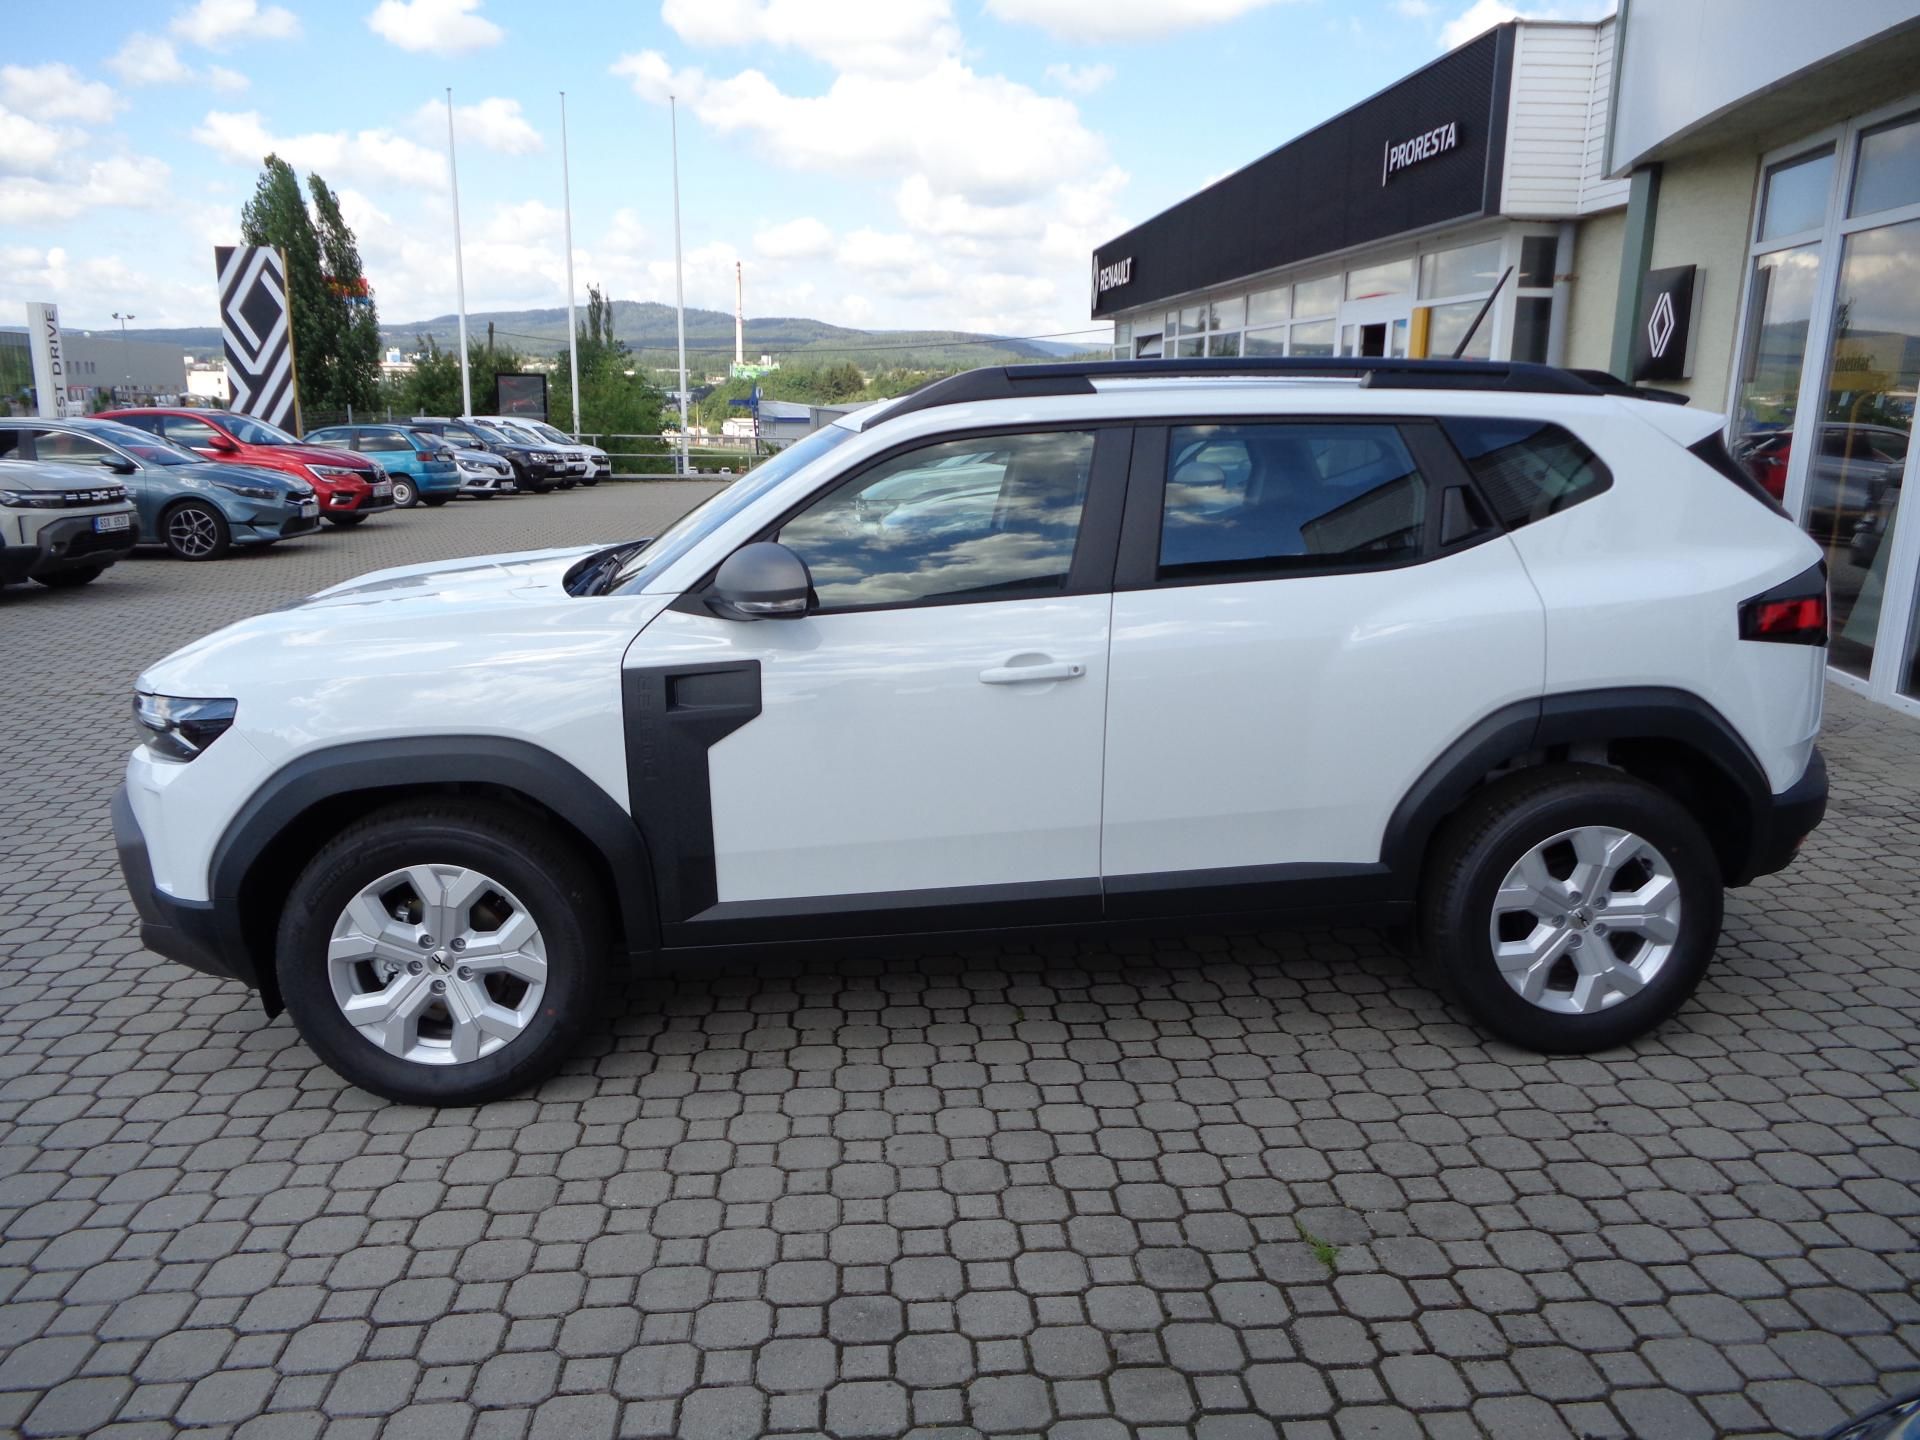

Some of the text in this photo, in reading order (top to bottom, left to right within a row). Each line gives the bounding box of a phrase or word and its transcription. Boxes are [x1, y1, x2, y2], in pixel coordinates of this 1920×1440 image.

[1389, 121, 1456, 173] PRORESTA
[1099, 256, 1132, 293] RENAULT
[44, 309, 62, 376] DRIVE
